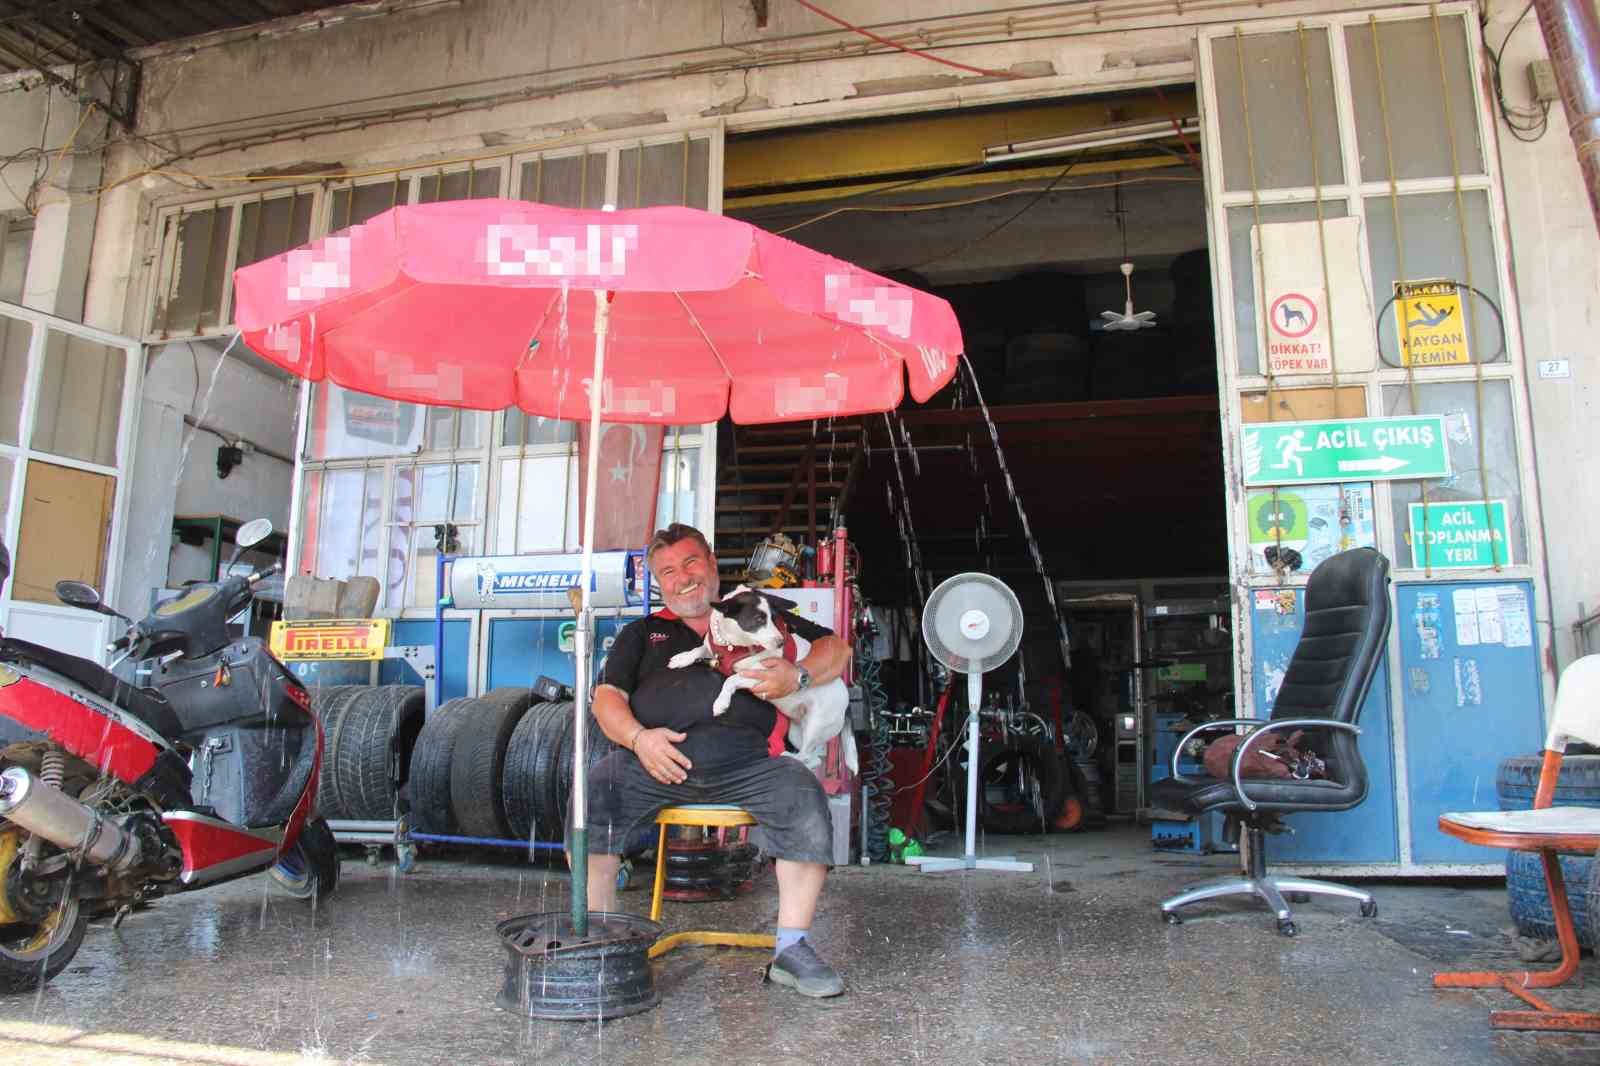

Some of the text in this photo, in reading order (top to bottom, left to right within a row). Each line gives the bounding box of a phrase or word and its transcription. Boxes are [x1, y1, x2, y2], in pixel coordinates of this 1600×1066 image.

[1306, 358, 1328, 368] VAR
[1316, 425, 1434, 451] ACİL ÇIKIŞ
[1441, 505, 1475, 526] ACİL
[1416, 528, 1504, 545] TOPLANMA
[285, 627, 369, 651] PIRELLI
